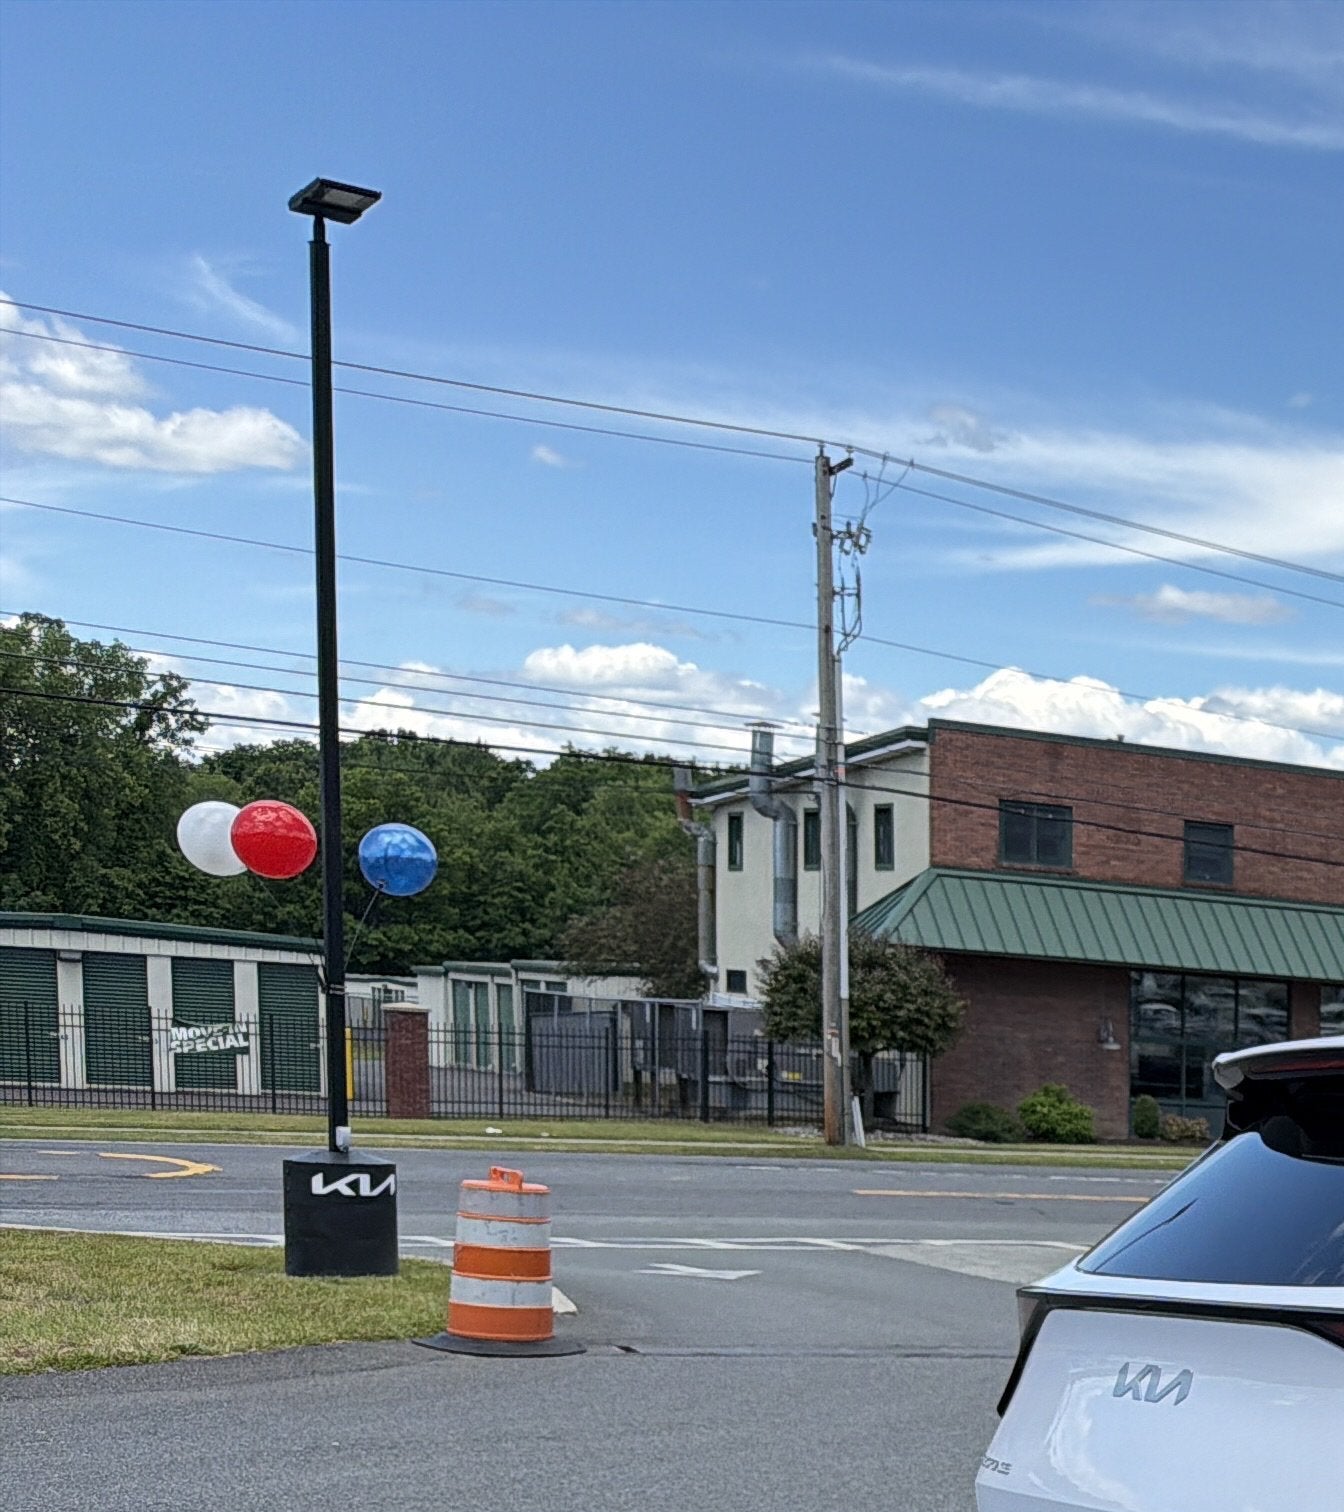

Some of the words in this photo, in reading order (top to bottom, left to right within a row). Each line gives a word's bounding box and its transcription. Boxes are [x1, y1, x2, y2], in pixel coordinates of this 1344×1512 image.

[170, 1033, 249, 1054] SPECIAL
[311, 1172, 395, 1197] KIA
[1113, 1361, 1194, 1406] KIA
